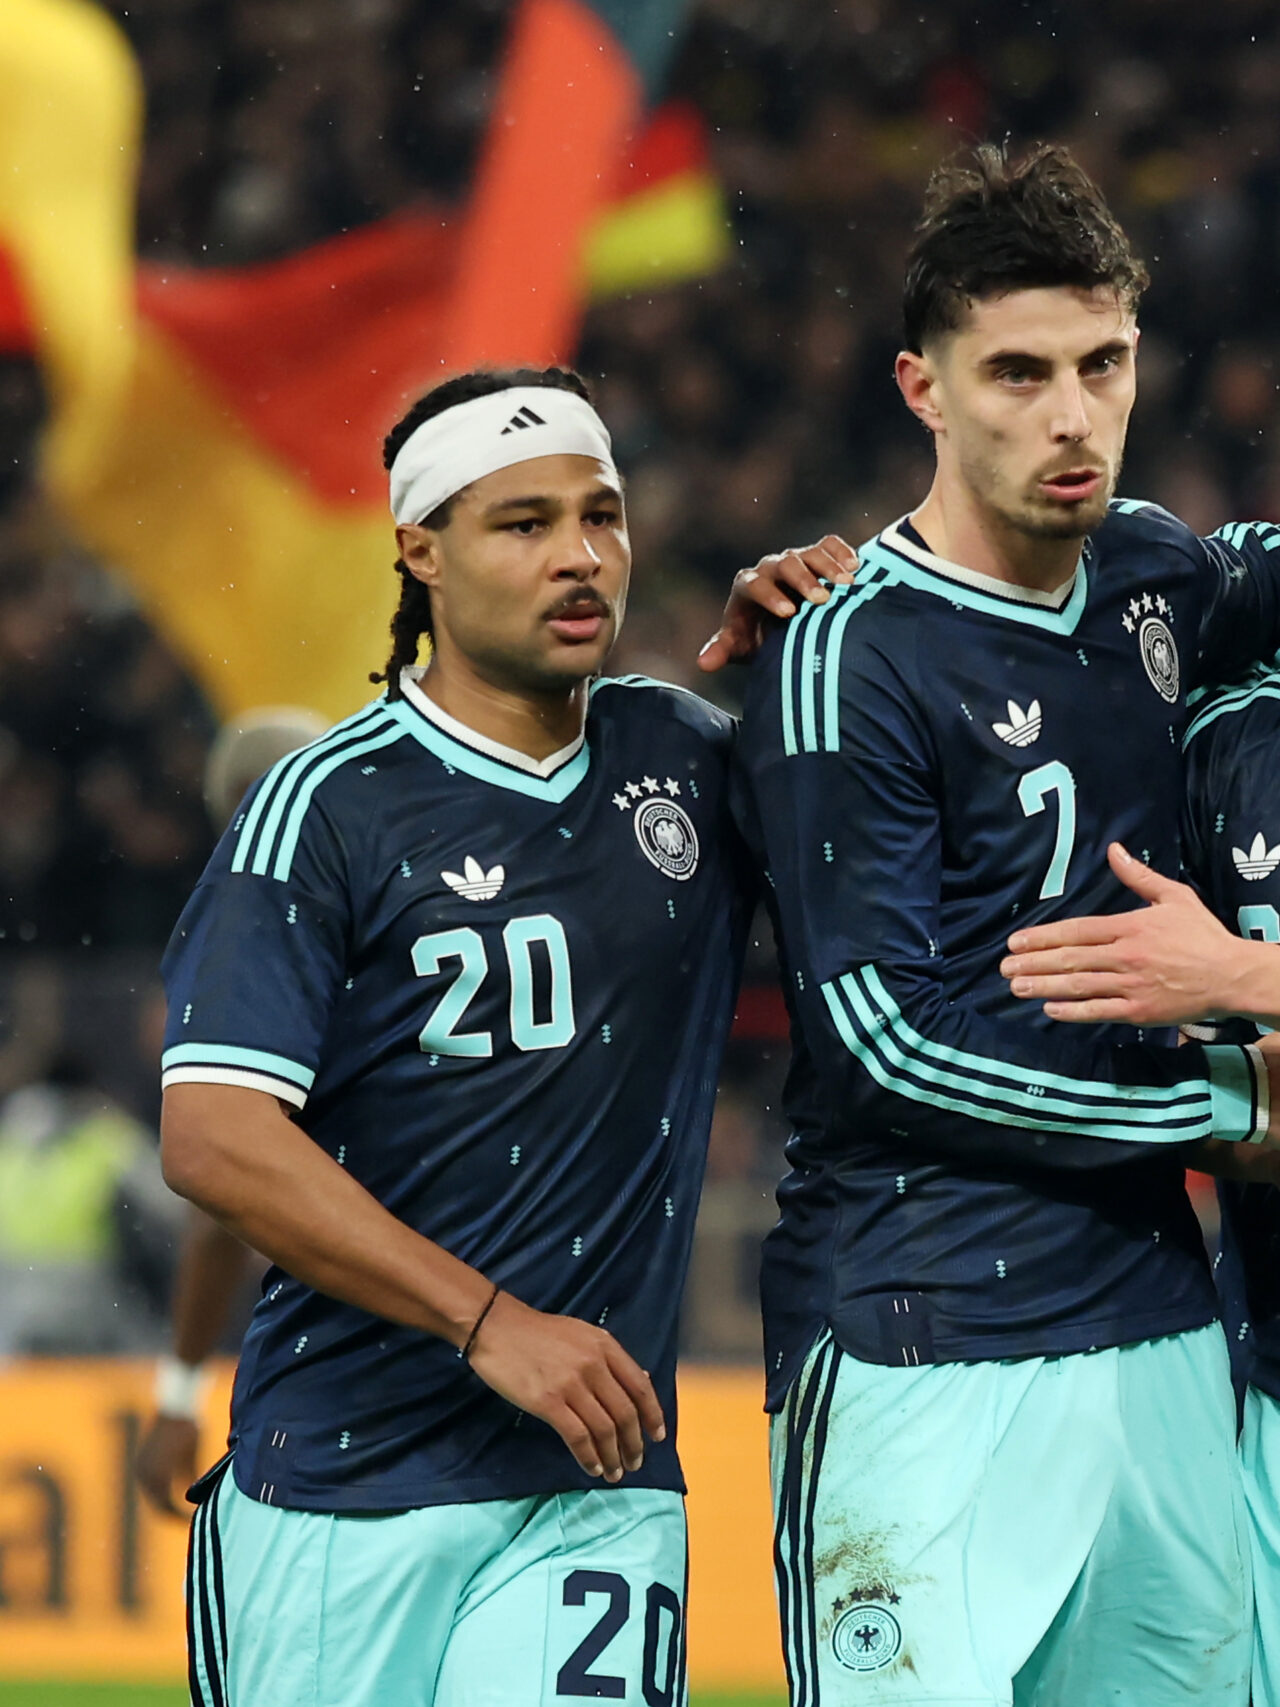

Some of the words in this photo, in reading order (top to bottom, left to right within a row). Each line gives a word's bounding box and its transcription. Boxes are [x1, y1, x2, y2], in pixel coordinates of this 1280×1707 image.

[1017, 760, 1076, 900] 7
[411, 914, 576, 1057] 20
[556, 1569, 680, 1707] 20
